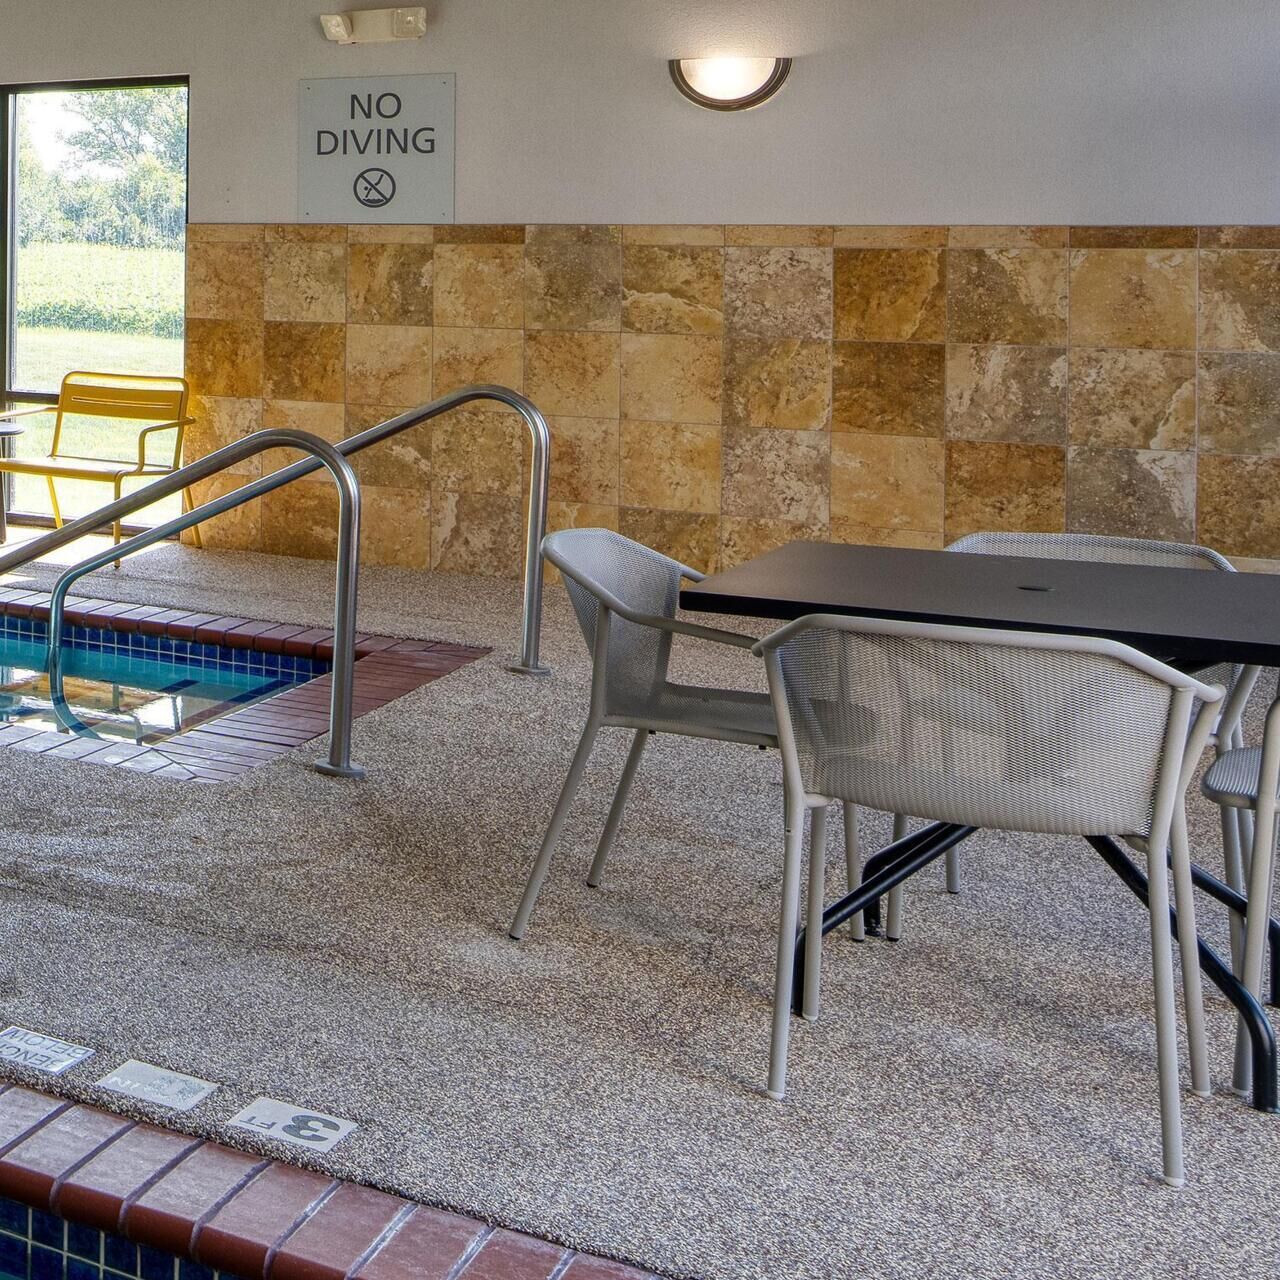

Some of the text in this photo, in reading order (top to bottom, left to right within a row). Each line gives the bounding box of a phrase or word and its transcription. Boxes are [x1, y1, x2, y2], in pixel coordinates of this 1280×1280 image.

[350, 93, 402, 120] NO
[316, 128, 435, 156] DIVING
[238, 1114, 342, 1142] 3 FT
